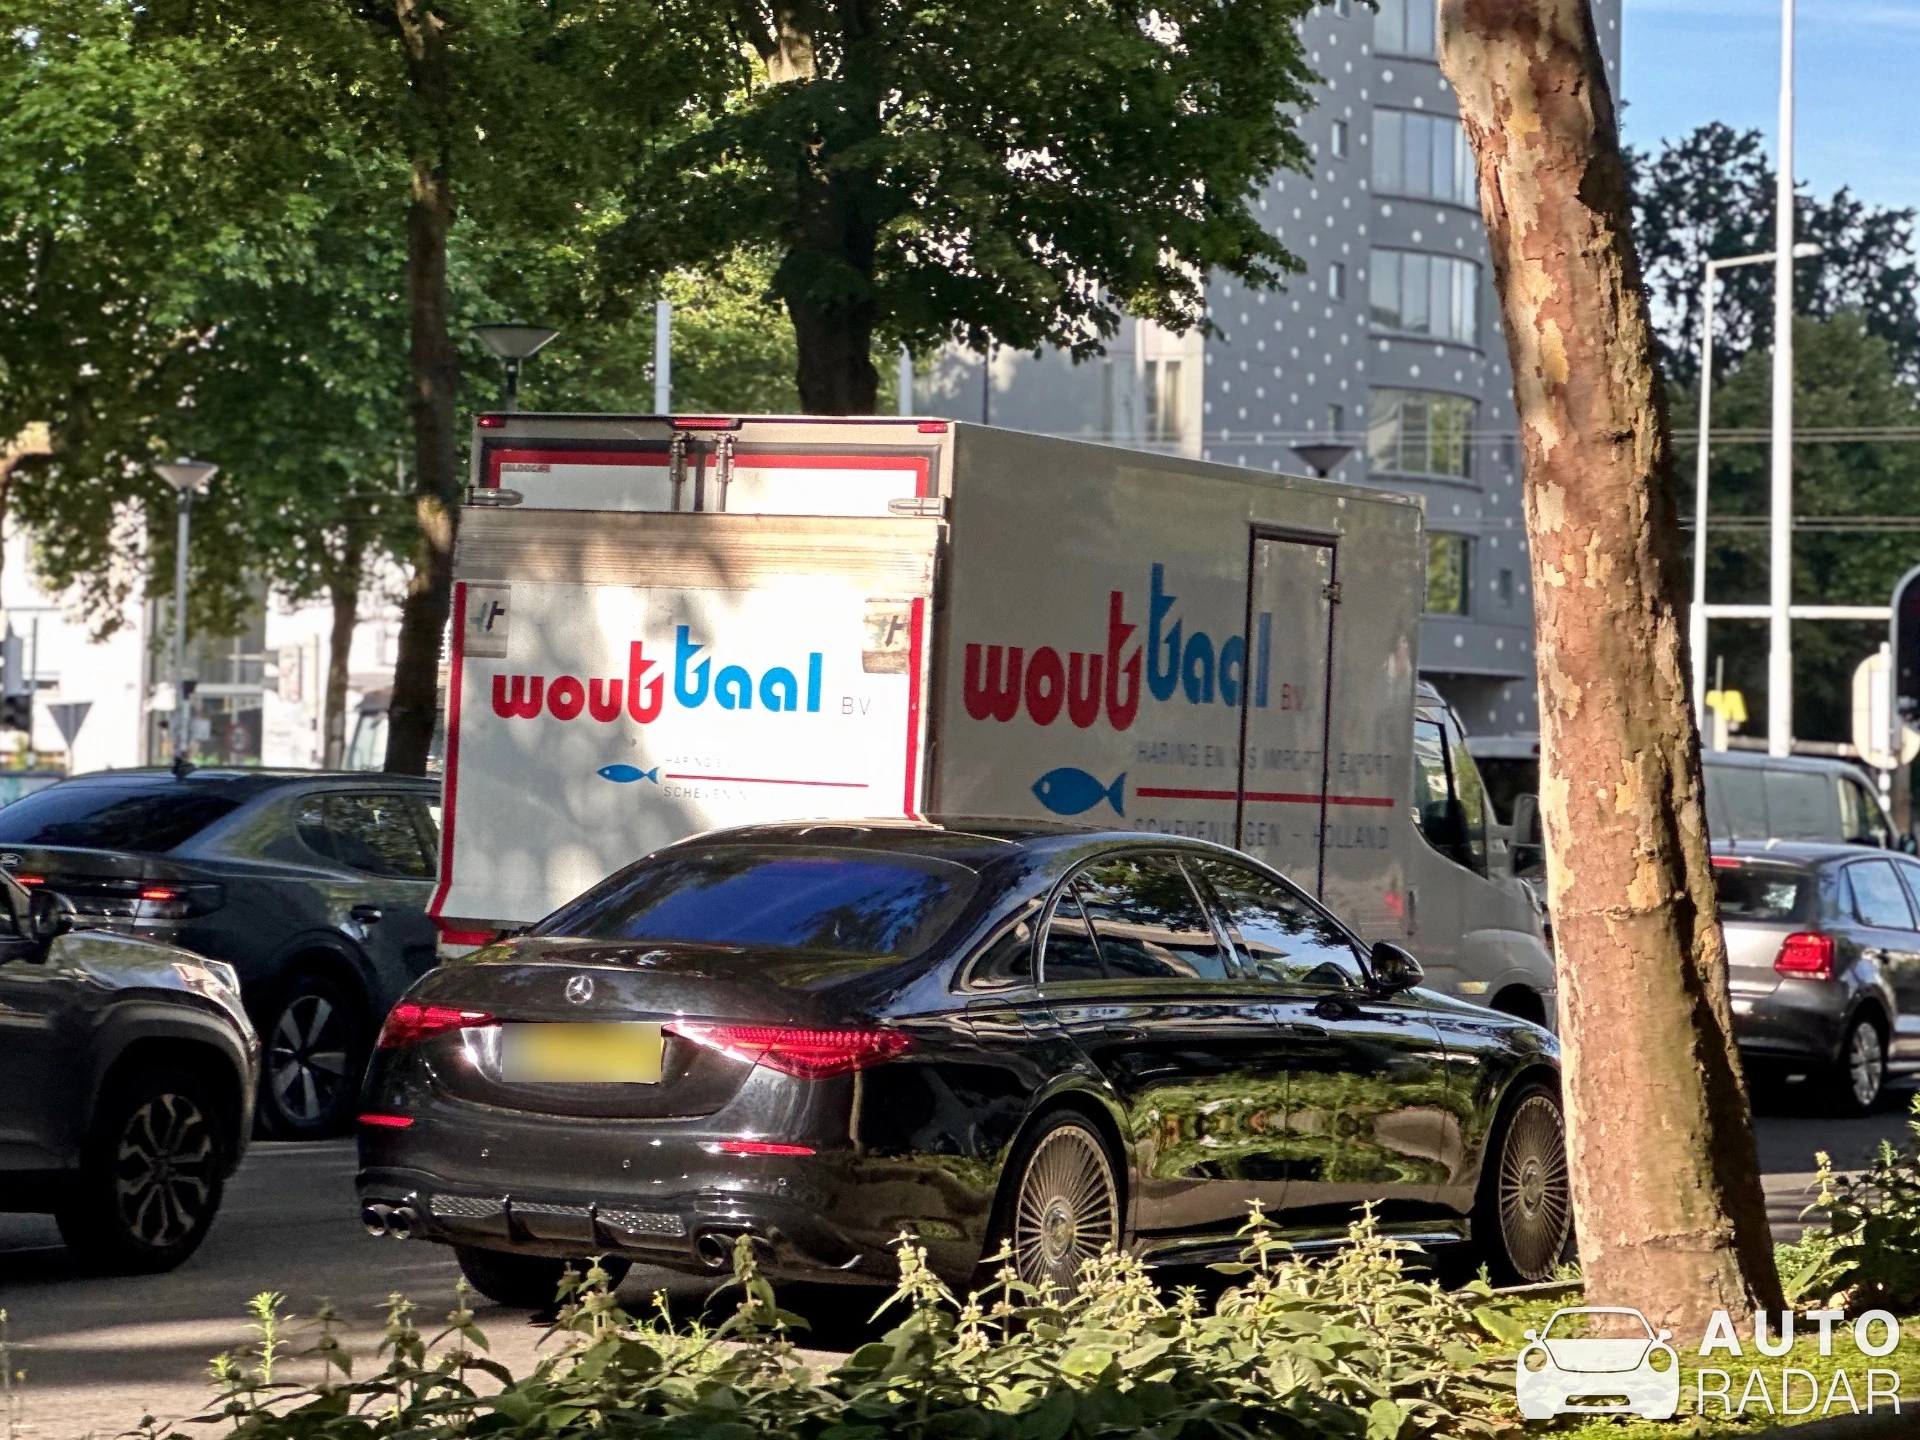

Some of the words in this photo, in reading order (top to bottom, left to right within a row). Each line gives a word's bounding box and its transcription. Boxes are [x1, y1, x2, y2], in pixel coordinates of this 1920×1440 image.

[492, 641, 664, 724] wout
[674, 625, 822, 712] taal
[842, 697, 871, 716] BV
[963, 590, 1142, 731] wout
[1138, 741, 1197, 767] HARING
[1205, 745, 1226, 769] EN
